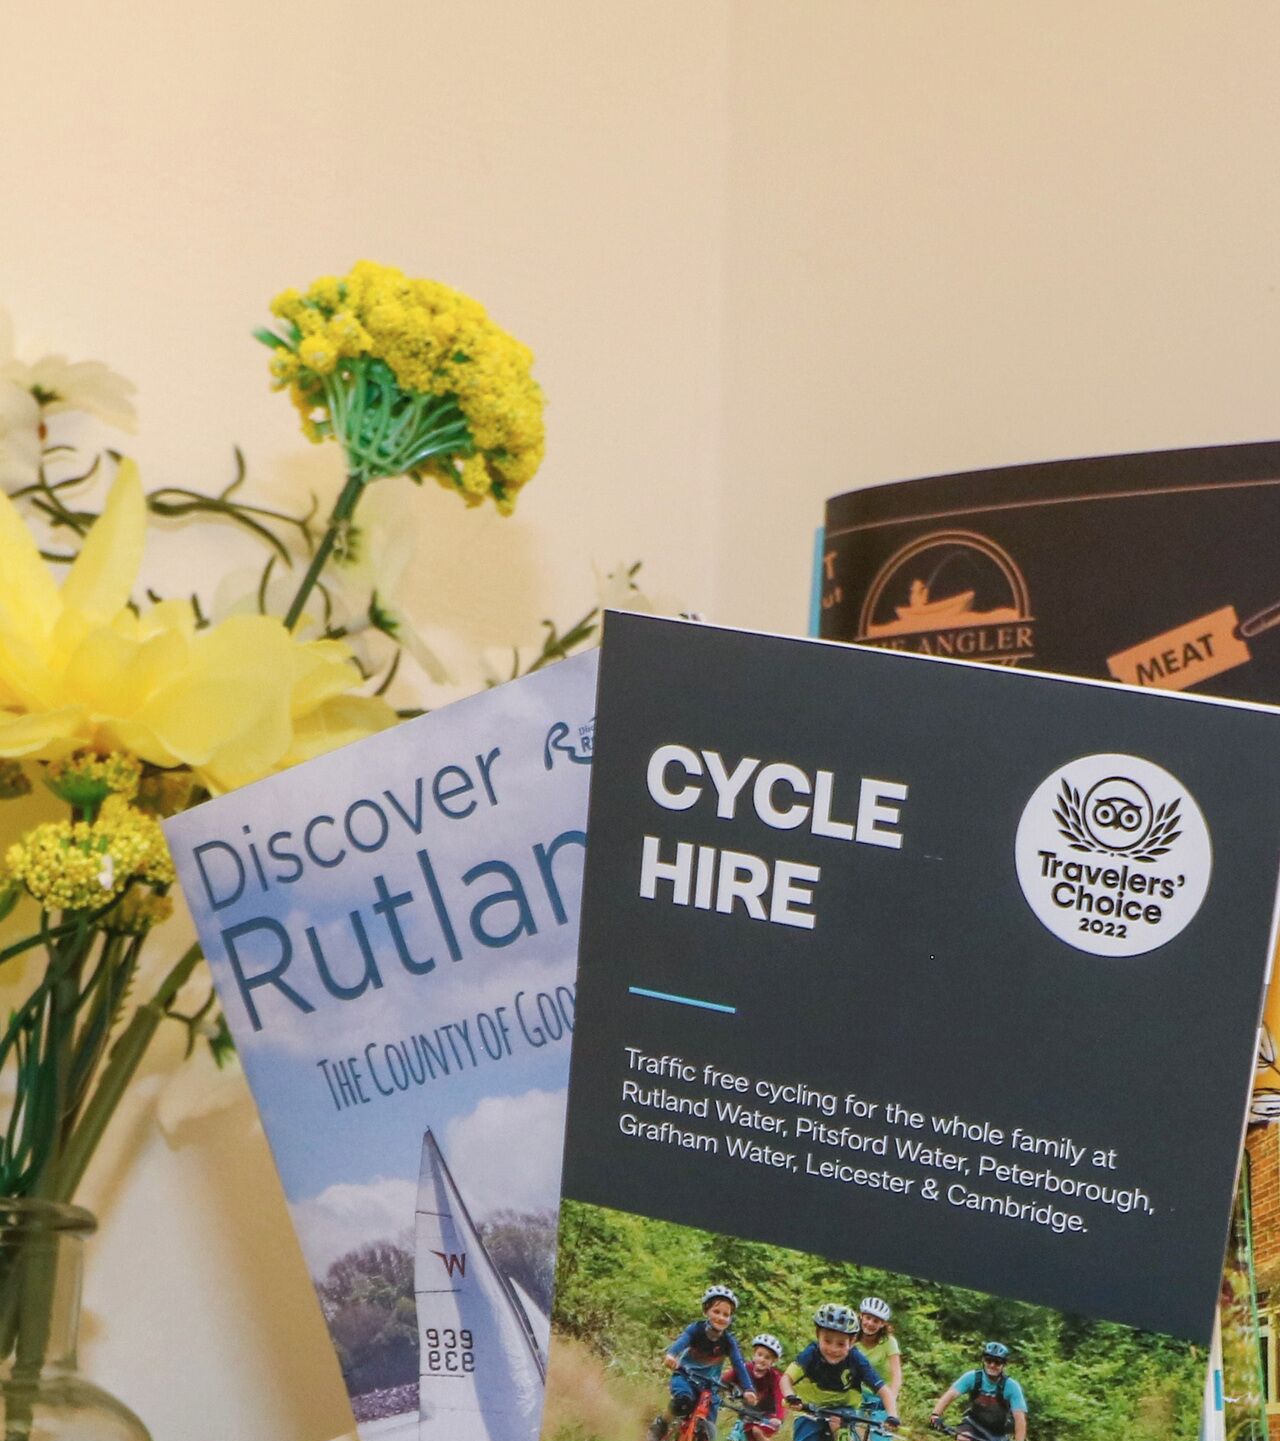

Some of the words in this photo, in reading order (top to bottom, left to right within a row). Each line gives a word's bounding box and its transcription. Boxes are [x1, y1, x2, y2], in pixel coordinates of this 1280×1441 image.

[918, 627, 1033, 656] ANGLER
[1135, 633, 1216, 686] MEAT
[192, 747, 501, 912] Discover
[646, 744, 909, 850] CYCLE
[639, 835, 821, 930] HIRE
[1037, 850, 1185, 899] Travelers'
[1051, 881, 1162, 925] Choice
[220, 830, 588, 1032] Rutlan
[1078, 917, 1128, 939] 2022
[514, 984, 577, 1048] GOO
[624, 1046, 697, 1082] Traffic
[703, 1065, 750, 1093] free
[755, 1079, 838, 1116] cycling
[845, 1093, 879, 1119] for
[885, 1103, 925, 1129] the
[931, 1115, 1005, 1146] whole
[1011, 1128, 1086, 1167] family
[1092, 1148, 1118, 1170] at
[619, 1113, 718, 1154] Grafham
[726, 1135, 799, 1174] Water,
[806, 1153, 915, 1195] Leicester
[921, 1178, 940, 1201] &
[947, 1183, 1089, 1234] Cambridge.
[622, 1080, 709, 1119] Rutland
[716, 1100, 789, 1138] Water,
[796, 1117, 889, 1157] Pitsford
[895, 1137, 971, 1176] Water,
[979, 1155, 1155, 1216] Peterborough,
[426, 1328, 474, 1350] 939
